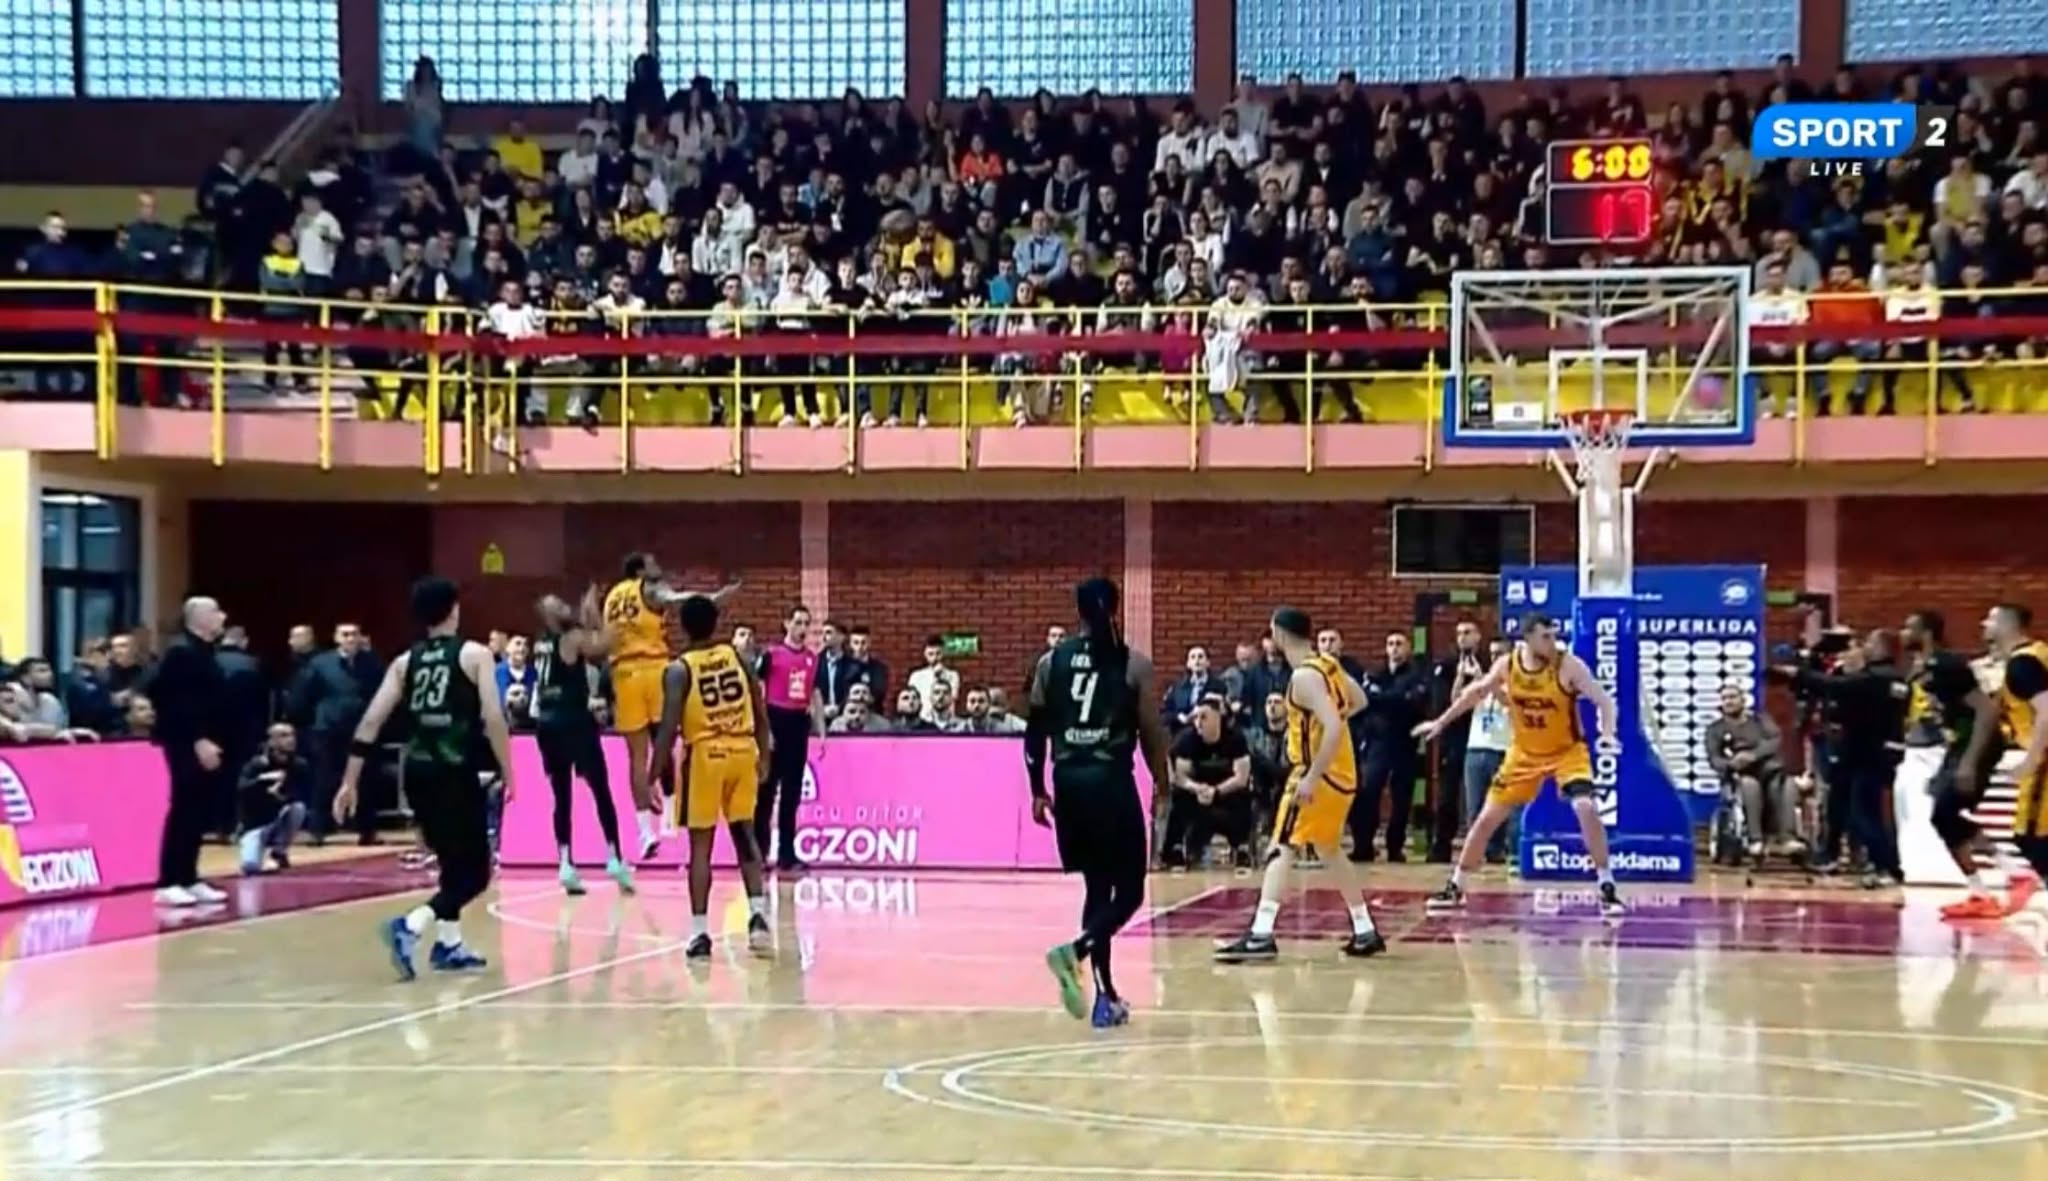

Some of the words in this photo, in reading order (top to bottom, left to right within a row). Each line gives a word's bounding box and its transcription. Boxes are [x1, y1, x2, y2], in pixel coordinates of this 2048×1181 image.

[410, 665, 450, 711] 23
[698, 670, 743, 707] 55
[1070, 671, 1099, 723] 4
